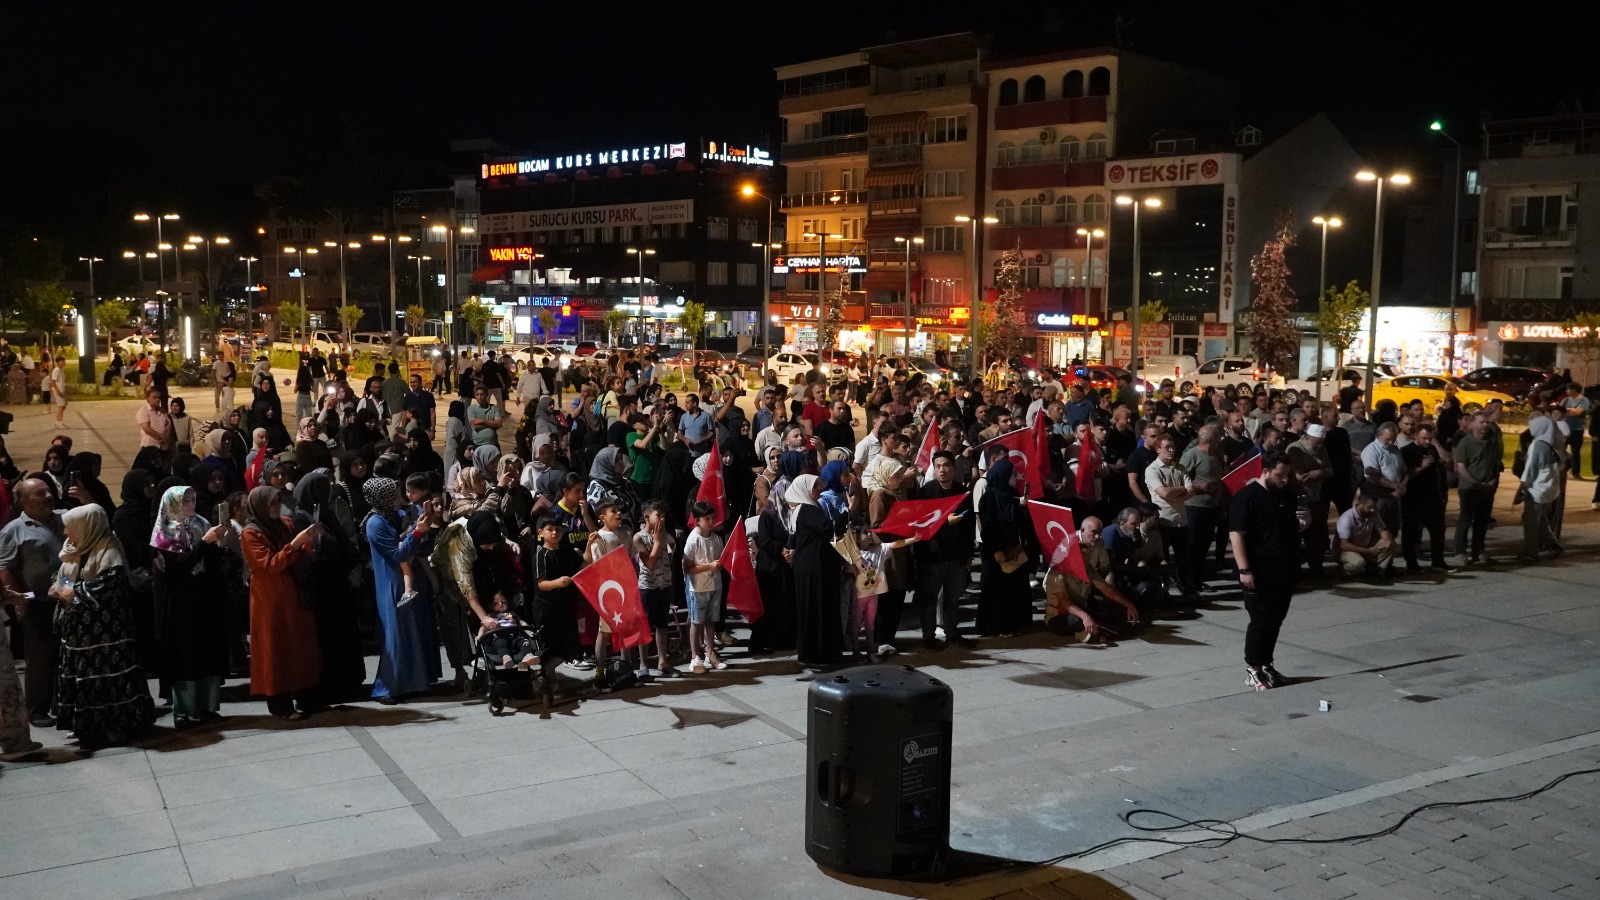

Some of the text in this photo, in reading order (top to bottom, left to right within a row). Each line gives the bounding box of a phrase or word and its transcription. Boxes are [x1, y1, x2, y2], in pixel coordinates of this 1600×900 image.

[519, 159, 549, 173] HOCAM
[556, 154, 592, 169] KURS
[1128, 160, 1198, 183] TEKSİF
[571, 209, 606, 225] KURSU
[608, 208, 637, 222] PARK
[490, 248, 515, 261] YAKIN
[1224, 197, 1236, 310] SENDİKASI
